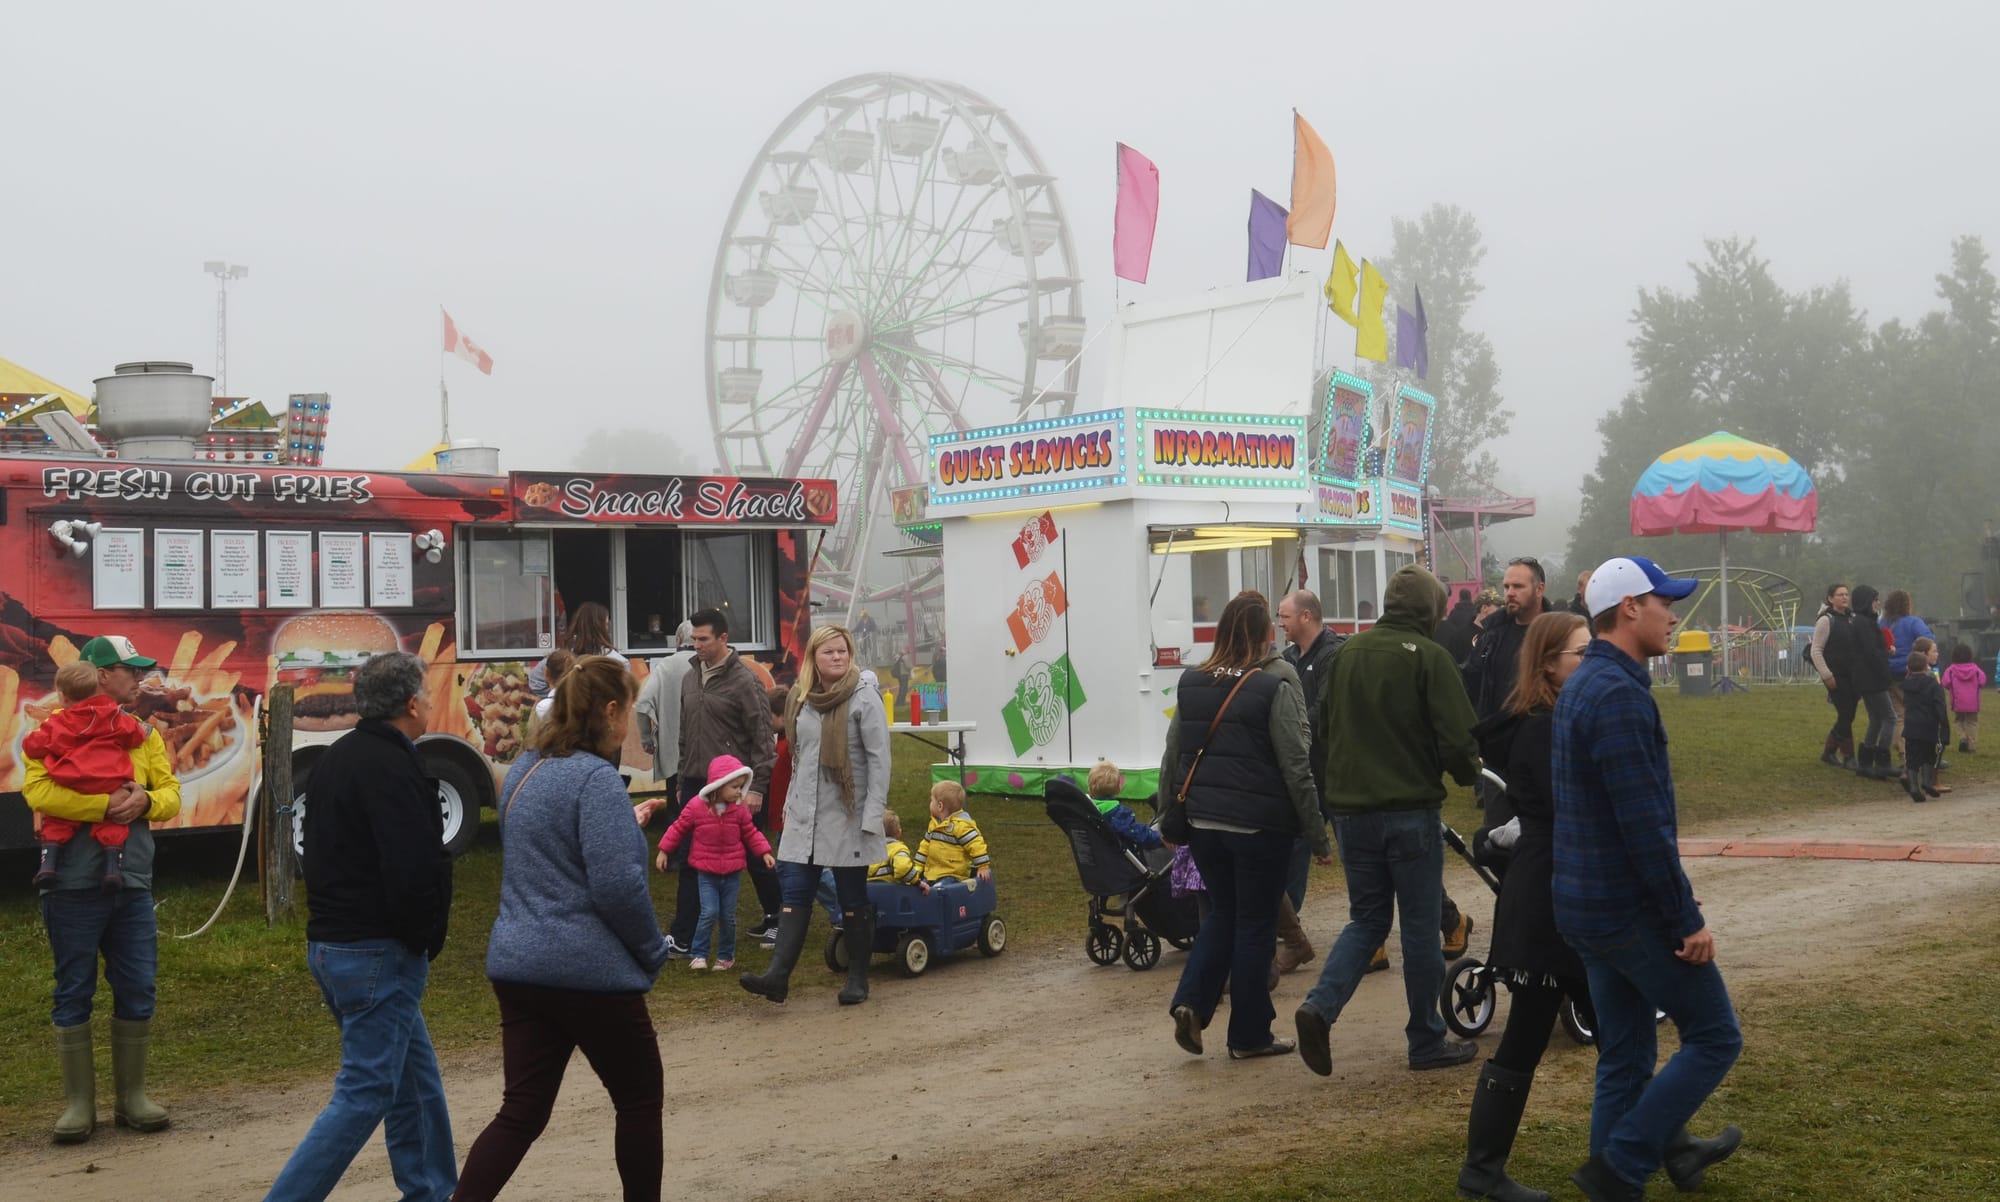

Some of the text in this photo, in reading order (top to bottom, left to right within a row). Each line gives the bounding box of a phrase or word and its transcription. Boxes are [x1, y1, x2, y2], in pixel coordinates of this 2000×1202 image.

[939, 429, 1112, 485] GUEST SERVICES
[1153, 429, 1295, 470] INFORMATION
[42, 467, 374, 504] FRESH CUT FRIES
[560, 477, 806, 520] Snack Shack
